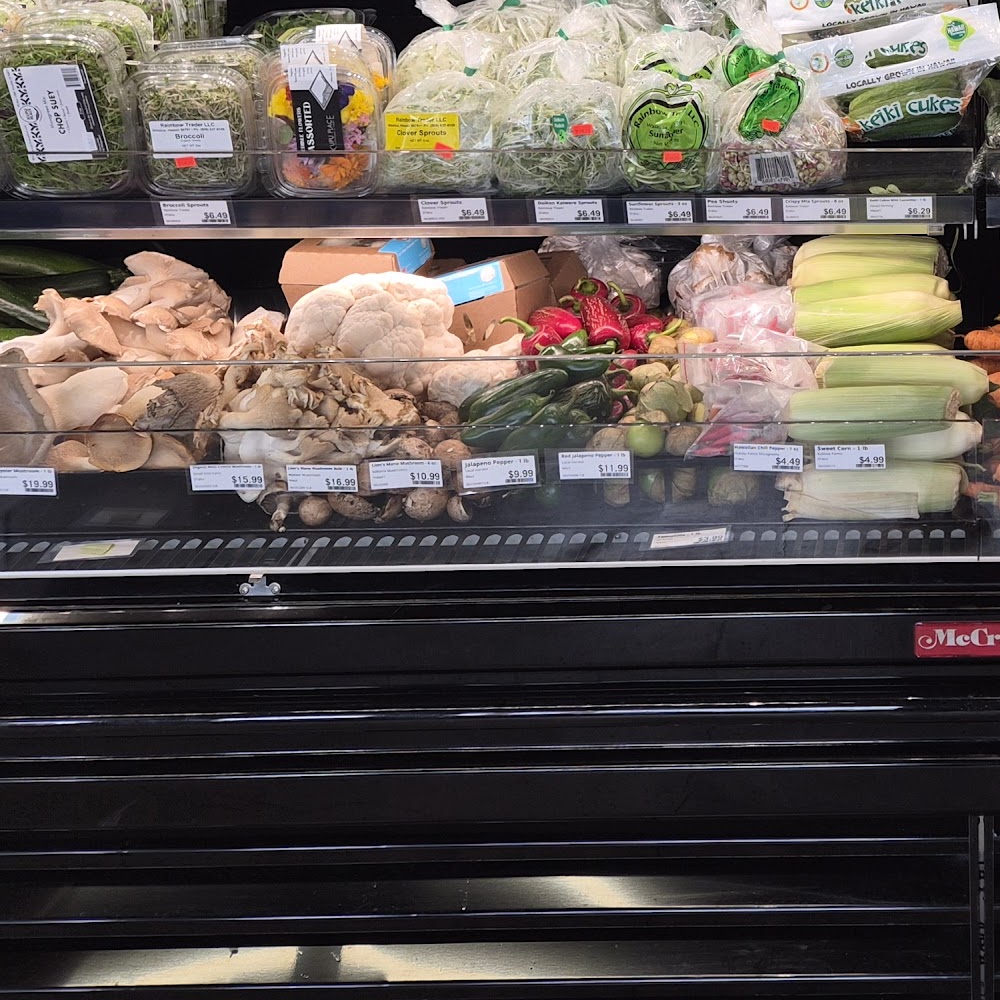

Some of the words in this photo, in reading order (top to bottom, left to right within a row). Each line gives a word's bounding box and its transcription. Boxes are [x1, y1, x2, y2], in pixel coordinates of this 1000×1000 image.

[846, 76, 881, 90] LOCALLY
[884, 70, 914, 81] GROWN
[46, 90, 59, 110] SUEY
[634, 108, 668, 128] Rainbow
[858, 103, 900, 132] keiki
[907, 96, 961, 114] cukes
[53, 112, 66, 135] CHOP
[303, 101, 315, 152] ASSORTED
[745, 208, 769, 216] $6.49
[823, 208, 847, 216] $6.49
[908, 207, 931, 215] $6.29
[204, 212, 228, 220] $6.49
[775, 457, 801, 466] $4.49
[859, 456, 884, 464] $4.99
[465, 461, 492, 469] Jalapeno
[598, 464, 629, 473] $11.99
[410, 472, 440, 480] $10.99
[508, 469, 534, 478] $9.99
[22, 480, 54, 489] $19.99
[232, 476, 263, 484] $15.99
[325, 478, 356, 487] $16.99
